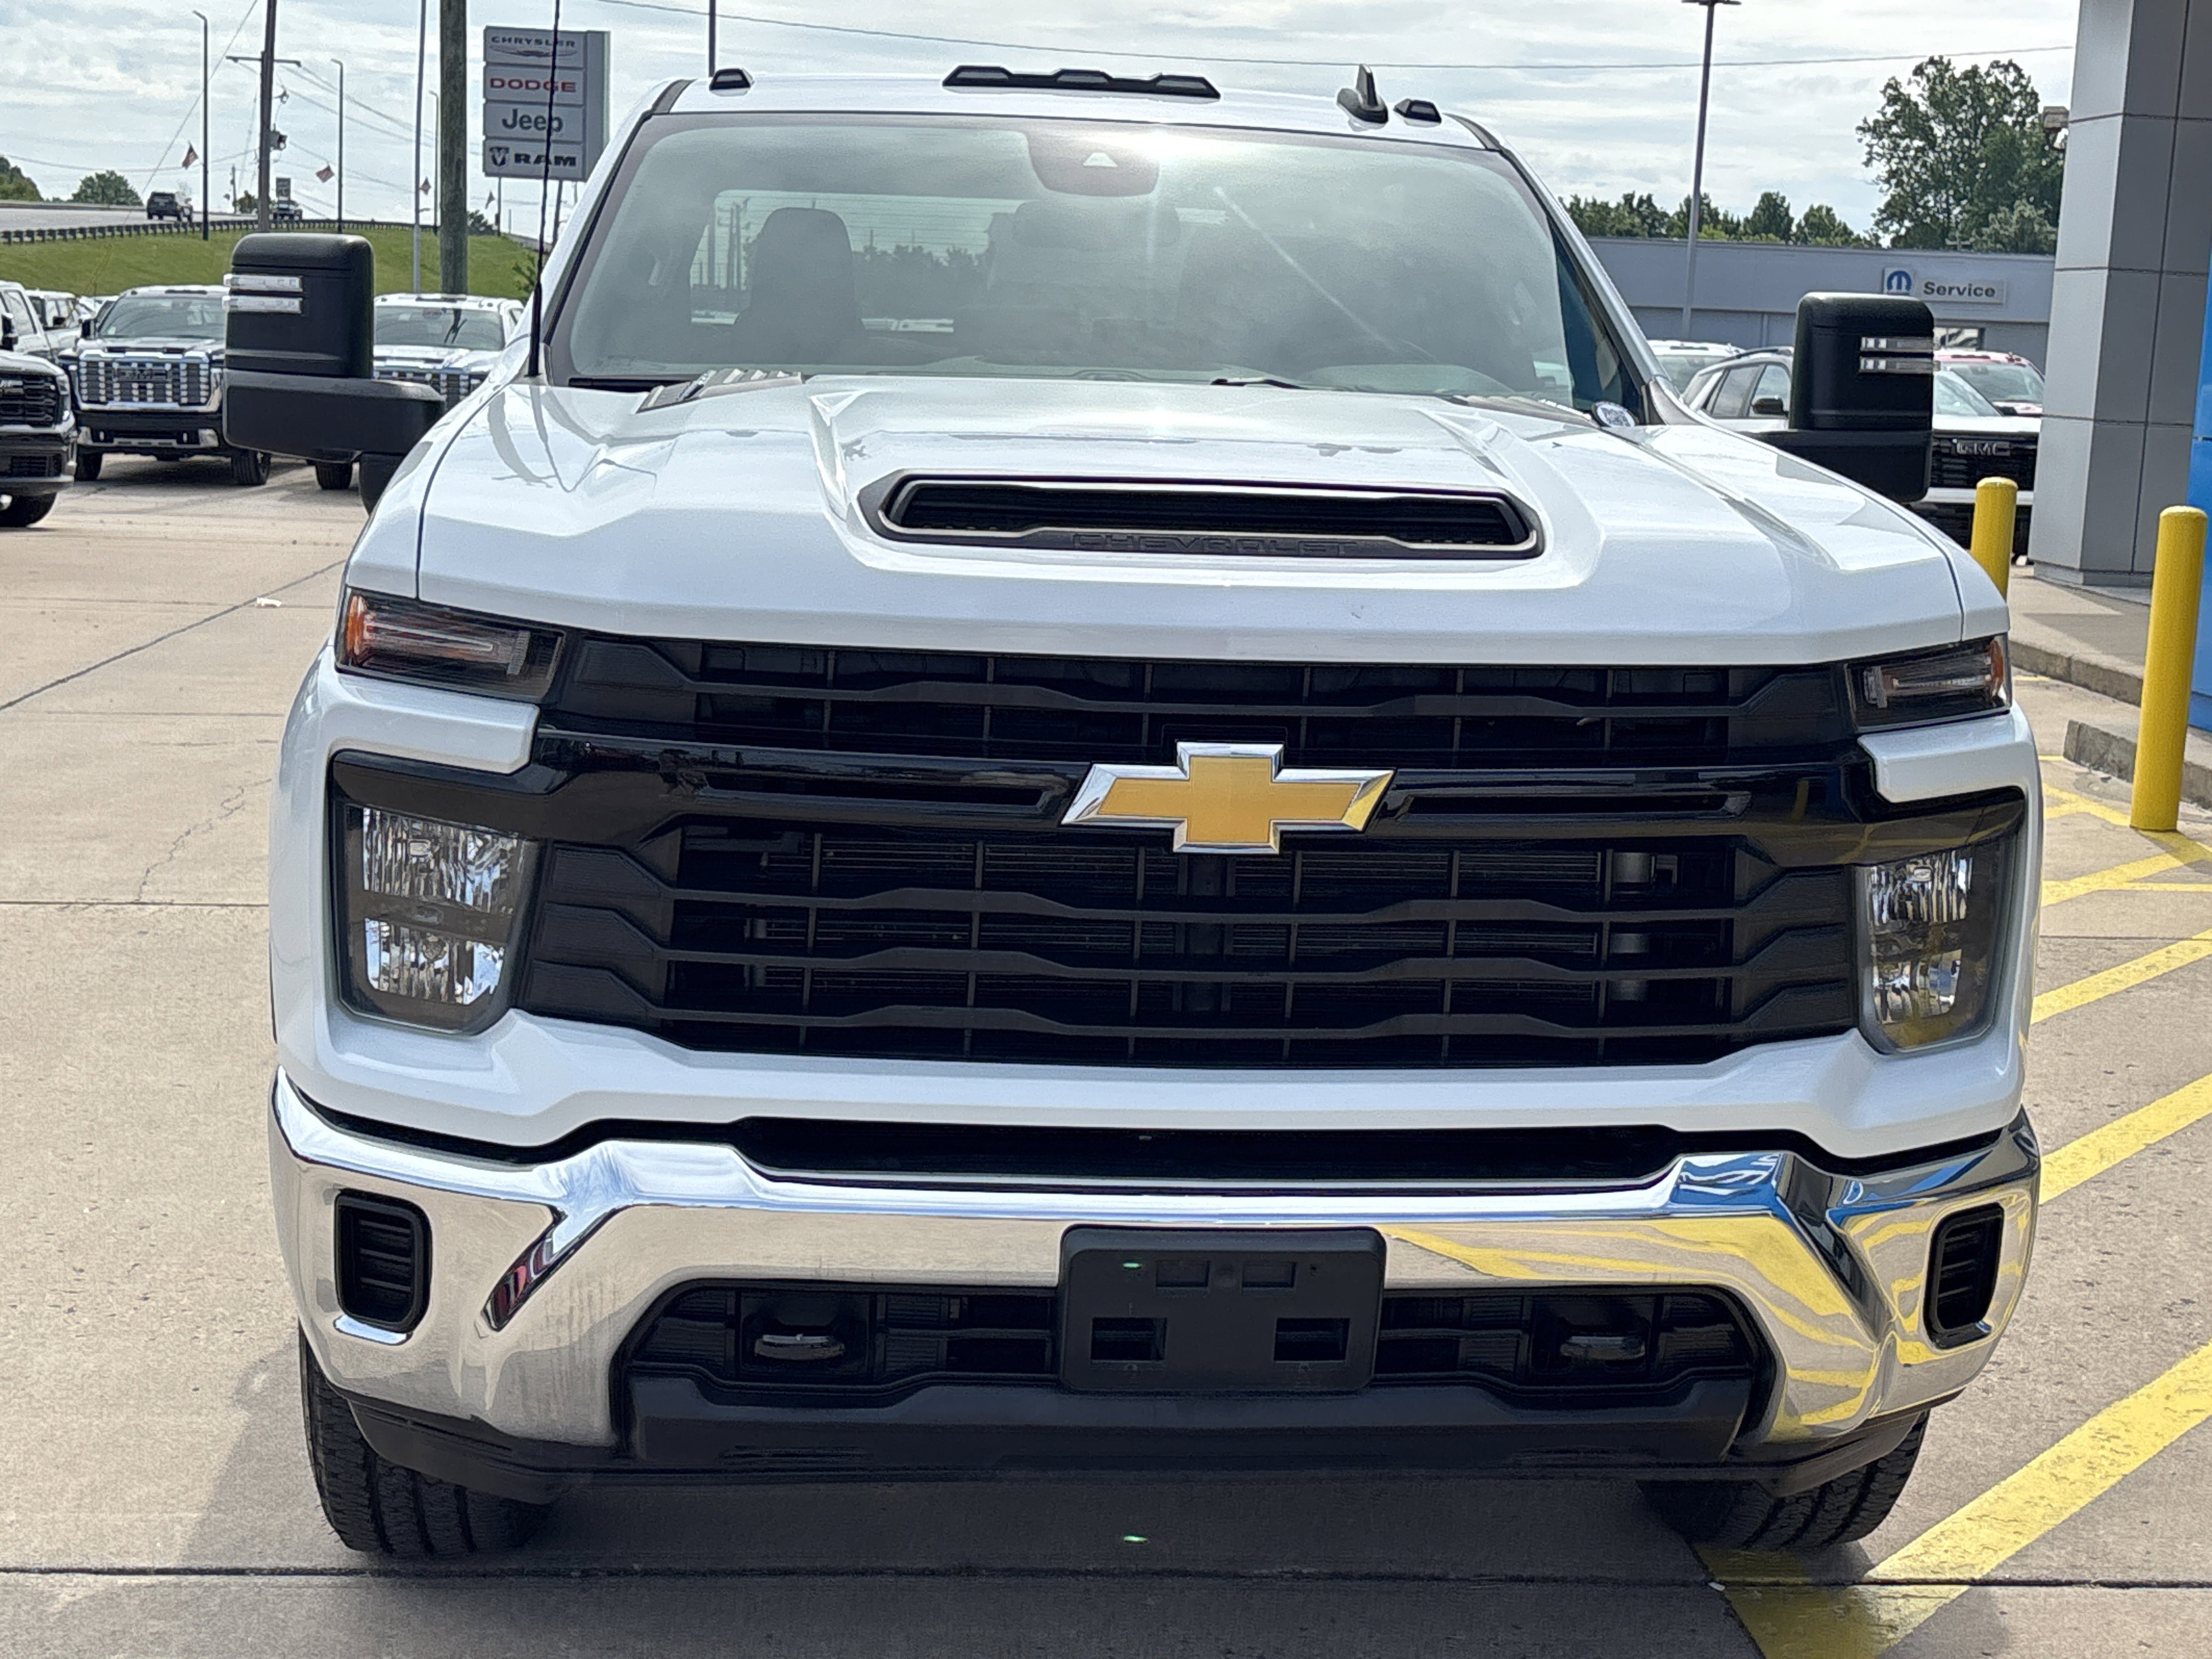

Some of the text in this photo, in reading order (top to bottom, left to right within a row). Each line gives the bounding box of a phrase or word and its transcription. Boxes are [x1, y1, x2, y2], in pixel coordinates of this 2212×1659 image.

[490, 78, 576, 92] DODGE
[502, 109, 563, 132] Jeep
[515, 153, 576, 167] RAM
[1923, 281, 1995, 297] Service
[1073, 534, 1357, 556] CHEVROLET
